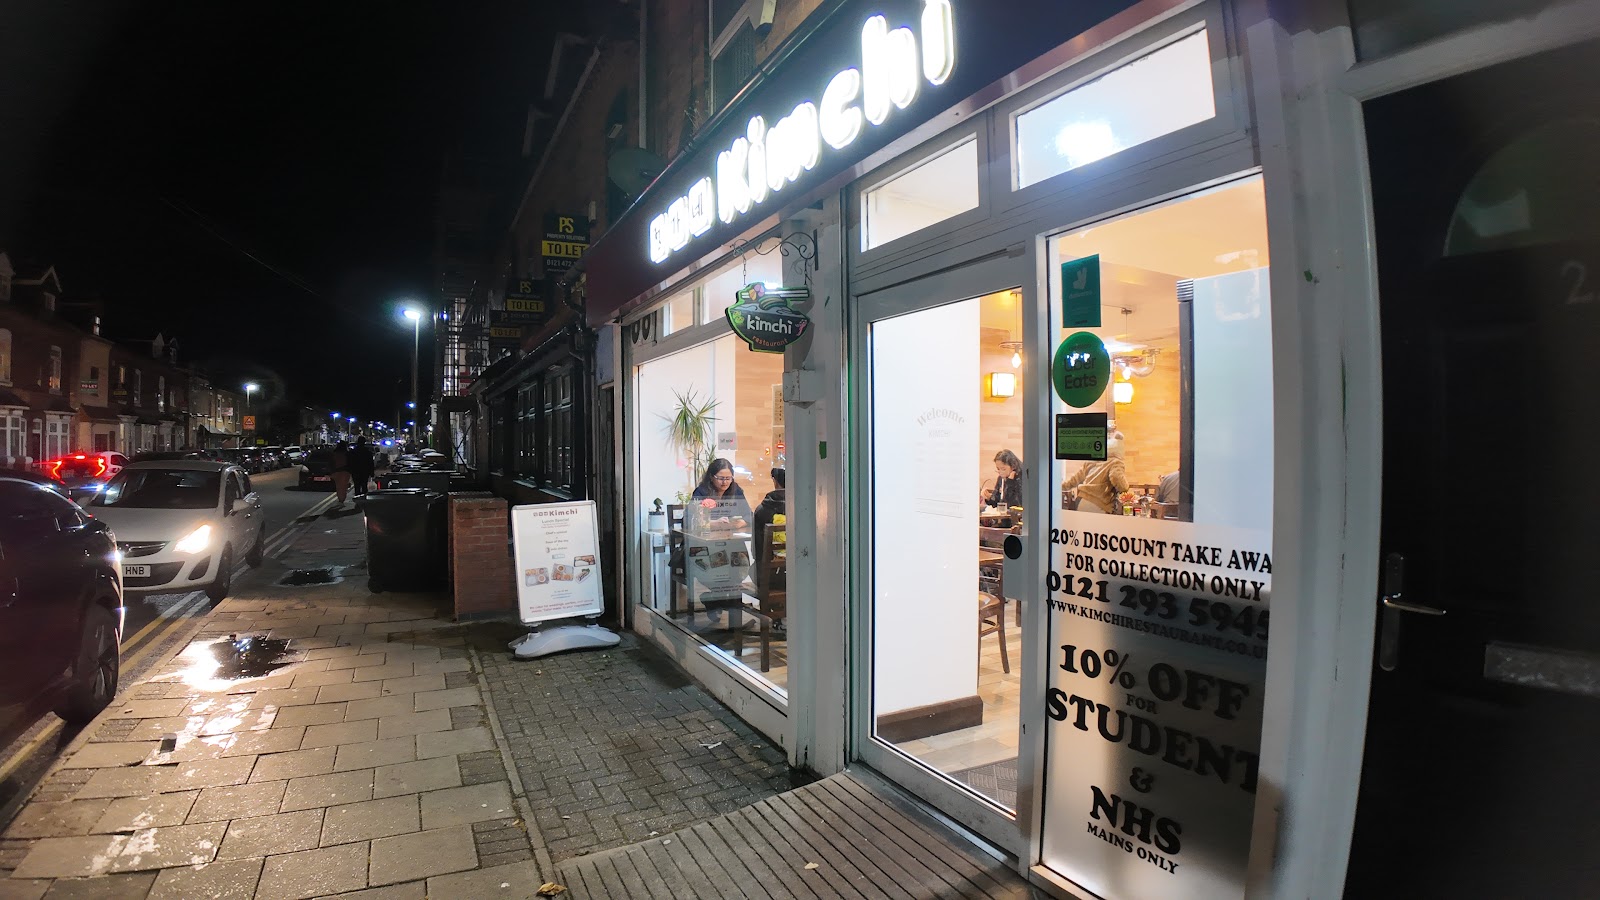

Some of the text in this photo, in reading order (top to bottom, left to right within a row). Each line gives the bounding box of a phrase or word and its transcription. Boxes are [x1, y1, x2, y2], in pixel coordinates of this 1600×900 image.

[717, 0, 955, 224] Kimchi
[559, 216, 575, 234] PS
[547, 243, 586, 256] TO LET
[511, 300, 540, 311] TO LET
[746, 314, 793, 334] kimchi
[752, 335, 789, 347] restaurant
[1063, 354, 1097, 372] Uber
[1064, 374, 1098, 390] Eats
[916, 407, 966, 427] Welcome
[1095, 441, 1101, 451] 5
[549, 508, 578, 517] Kimchi
[1051, 528, 1272, 574] 20% DISCOUNT TAKE AWA
[125, 566, 145, 575] HNB
[1065, 552, 1265, 601] FOR COLLECTION ONLY
[1046, 571, 1271, 641] 0121 293 5945
[1046, 599, 1267, 660] WWW.KIMCHIRESTAURANT.CO.U
[1059, 644, 1250, 721] 10% OFF
[1125, 693, 1159, 715] FOR
[1047, 687, 1260, 794] STUDENT
[1129, 766, 1154, 793] &
[1089, 785, 1182, 855] NHS
[1087, 821, 1179, 875] MAINS ONLY
